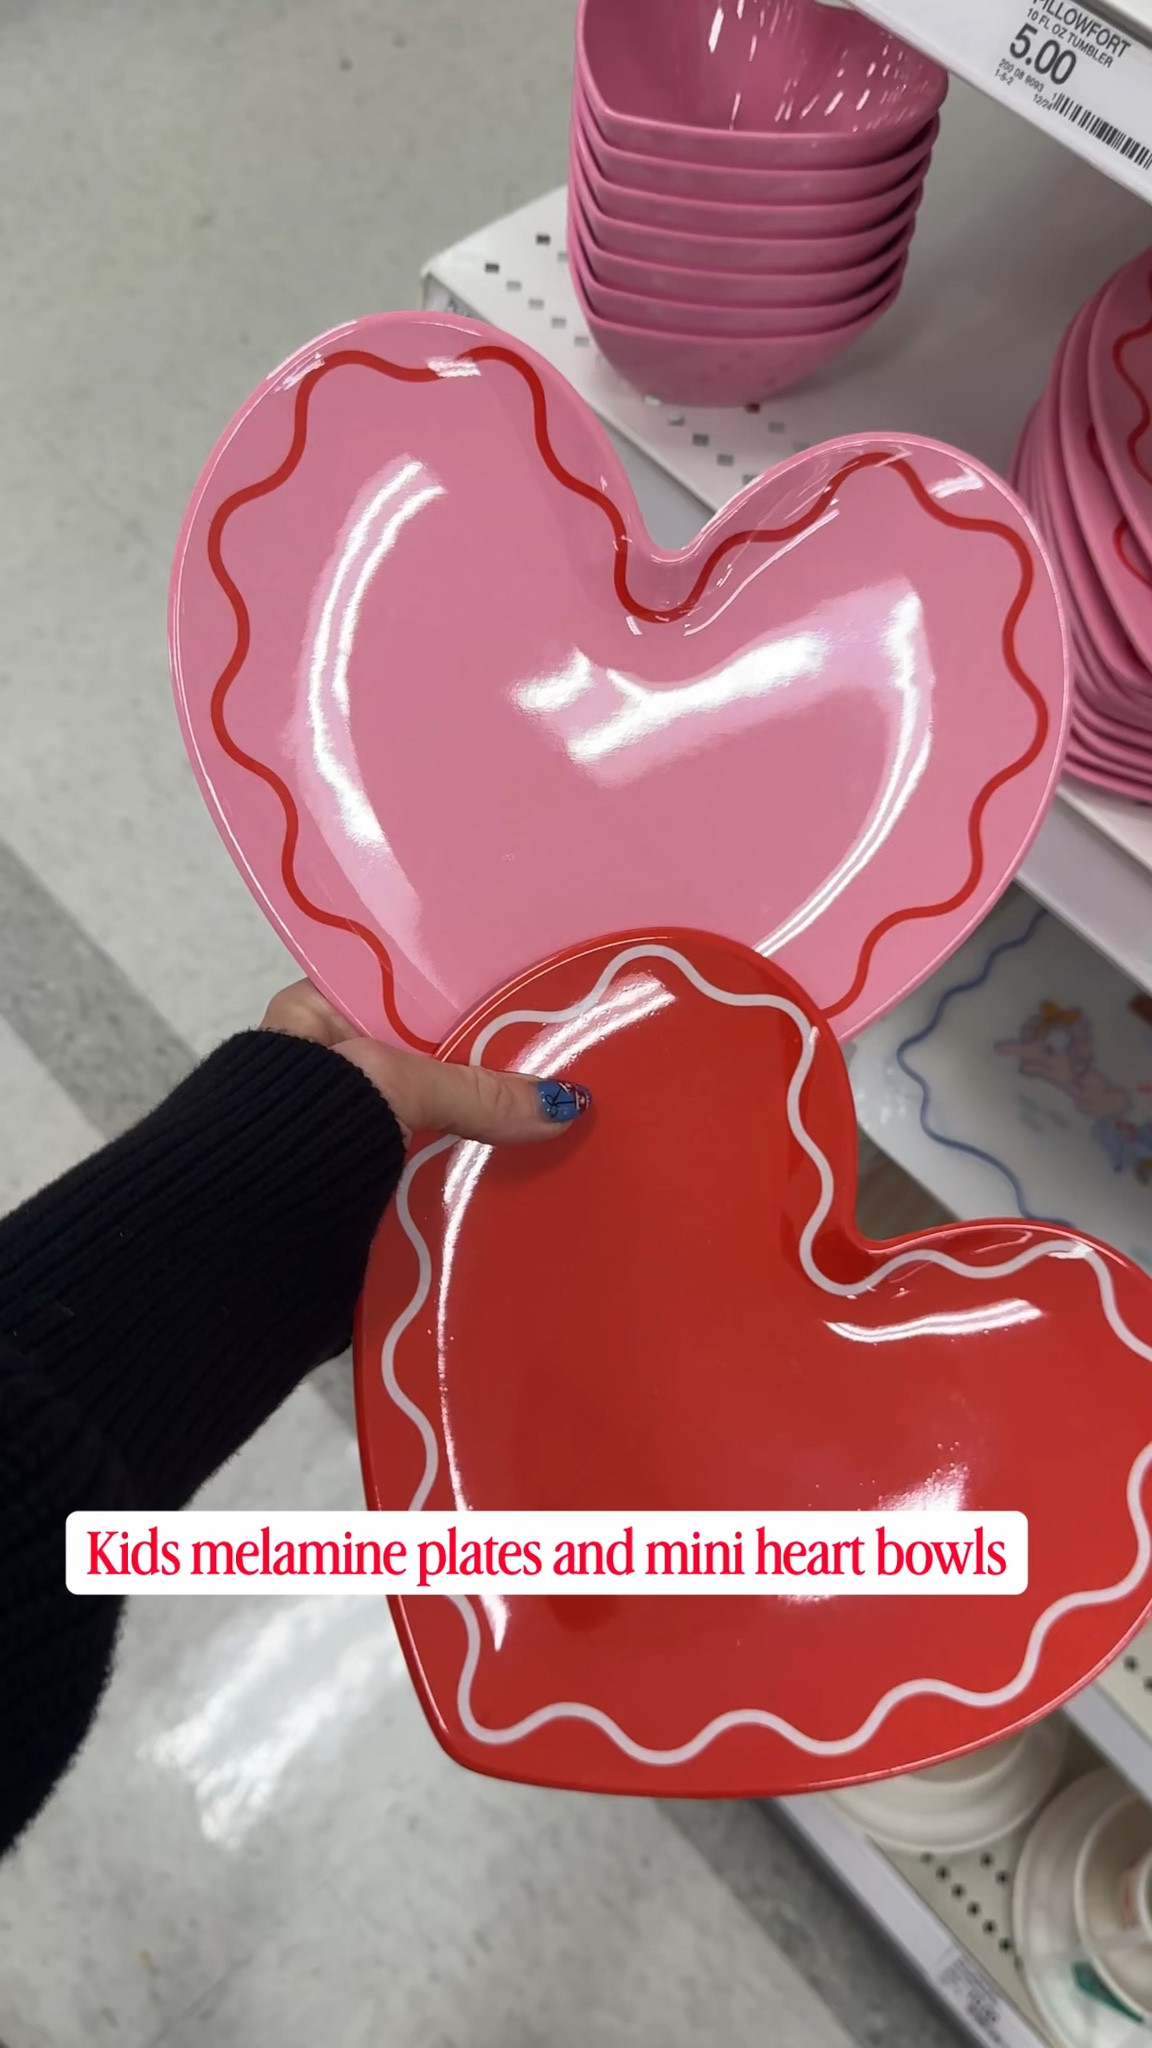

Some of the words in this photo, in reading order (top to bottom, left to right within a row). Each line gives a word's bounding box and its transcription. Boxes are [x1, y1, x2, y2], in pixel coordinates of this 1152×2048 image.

[1009, 22, 1077, 85] 5.00
[1026, 8, 1039, 21] 10
[1038, 15, 1050, 30] FL
[1051, 23, 1068, 40] OZ
[1066, 32, 1114, 68] TUMBLER
[1032, 93, 1054, 111] 12/24
